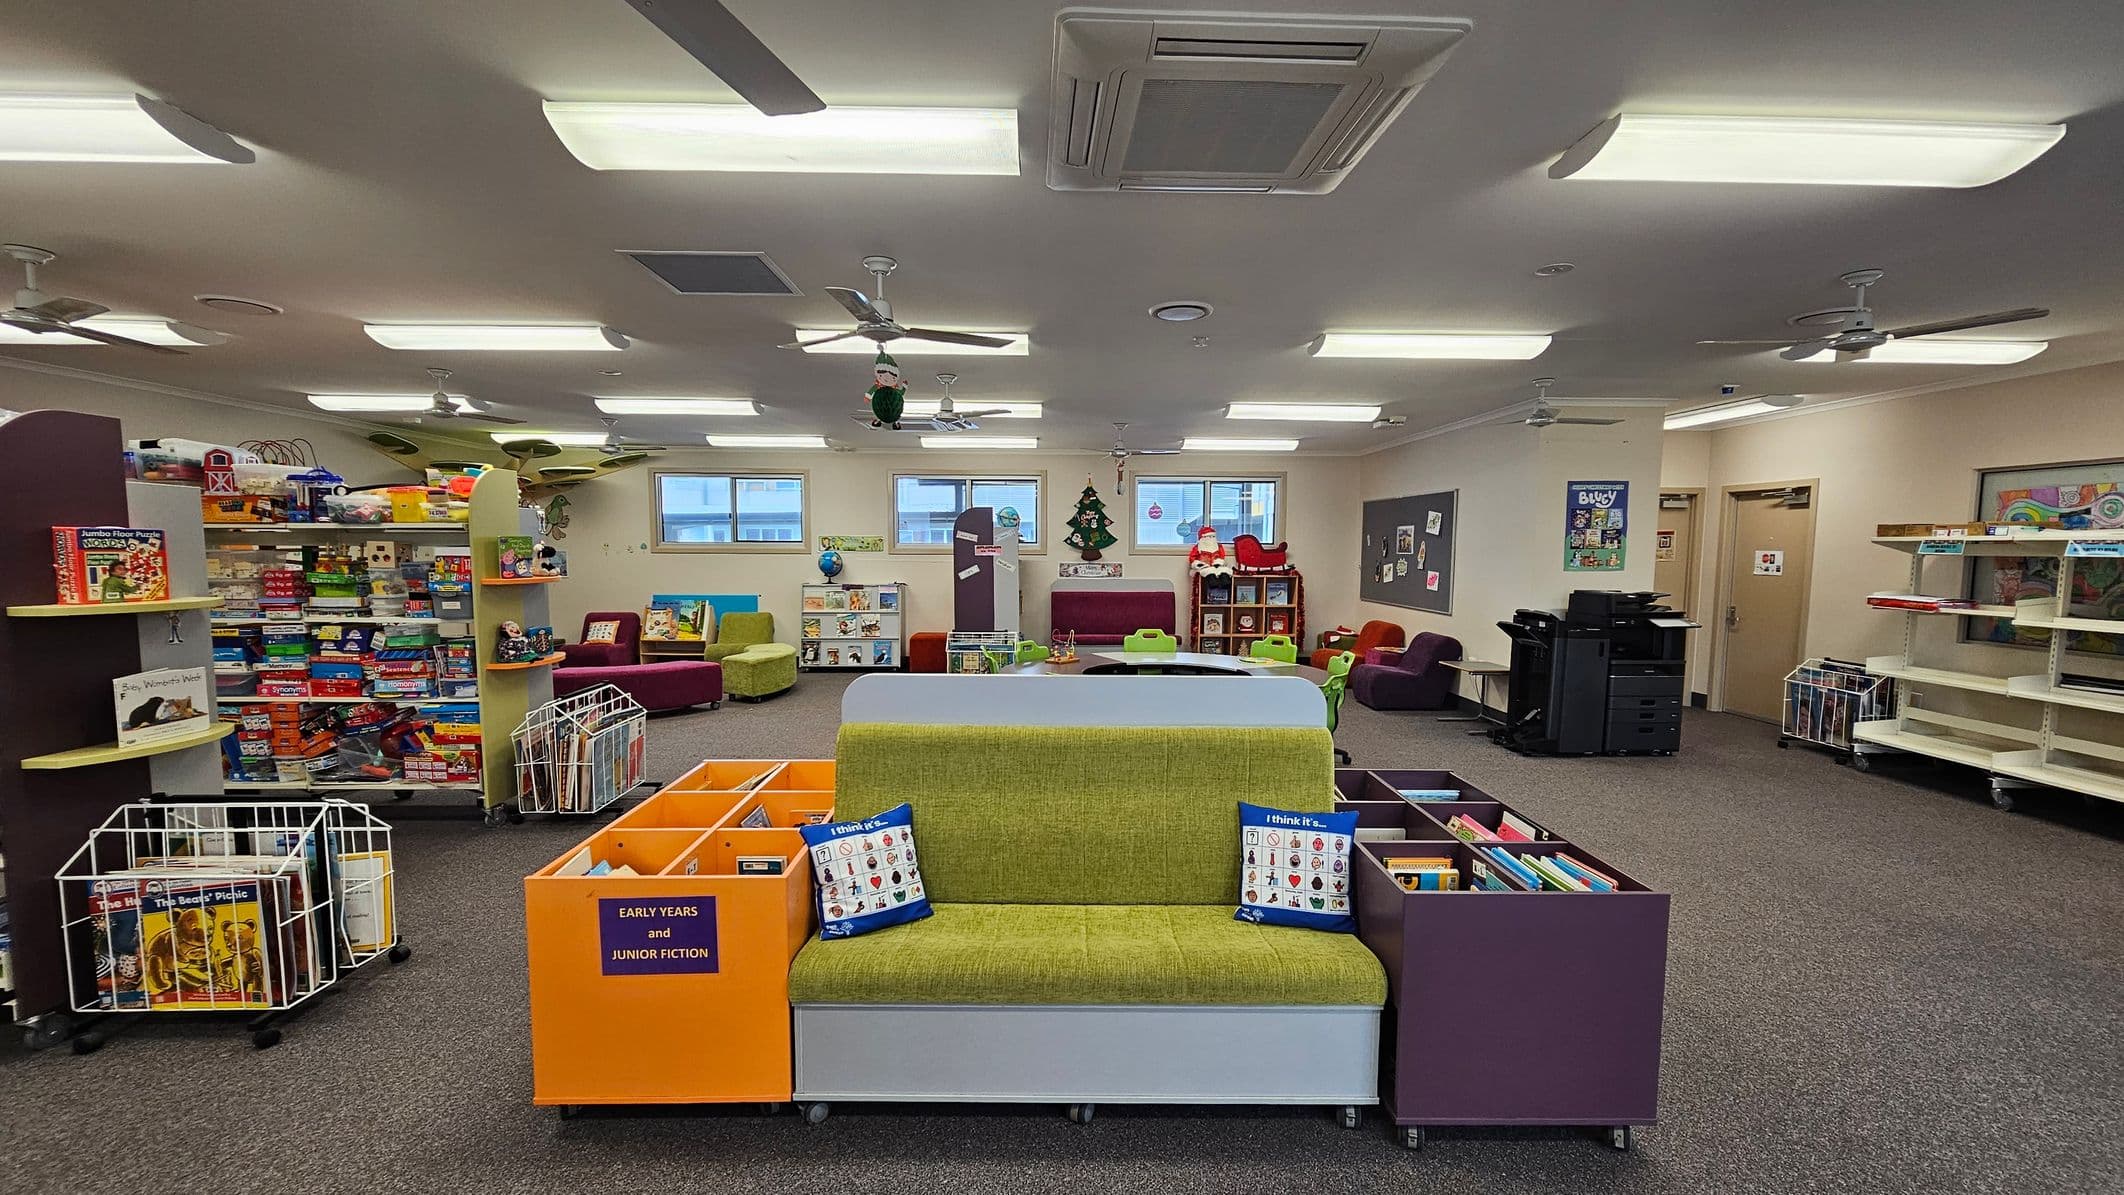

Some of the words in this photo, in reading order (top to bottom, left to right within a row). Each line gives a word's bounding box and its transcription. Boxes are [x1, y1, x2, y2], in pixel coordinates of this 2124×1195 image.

[113, 530, 134, 538] Floor
[82, 538, 127, 548] WORDS
[143, 675, 180, 688] Wombat's
[388, 681, 426, 689] Homonyms
[272, 686, 306, 694] Synonyms
[1266, 814, 1271, 823] I
[1272, 815, 1300, 826] think
[830, 828, 836, 836] I
[836, 824, 863, 834] think
[96, 900, 122, 910] The
[154, 897, 176, 908] The
[179, 893, 213, 905] Bears'
[215, 890, 248, 901] Picnic
[619, 907, 657, 918] EARLY
[660, 906, 698, 917] YEARS
[648, 927, 671, 939] and
[612, 949, 657, 961] JUNIOR
[661, 948, 708, 959] FICTION
